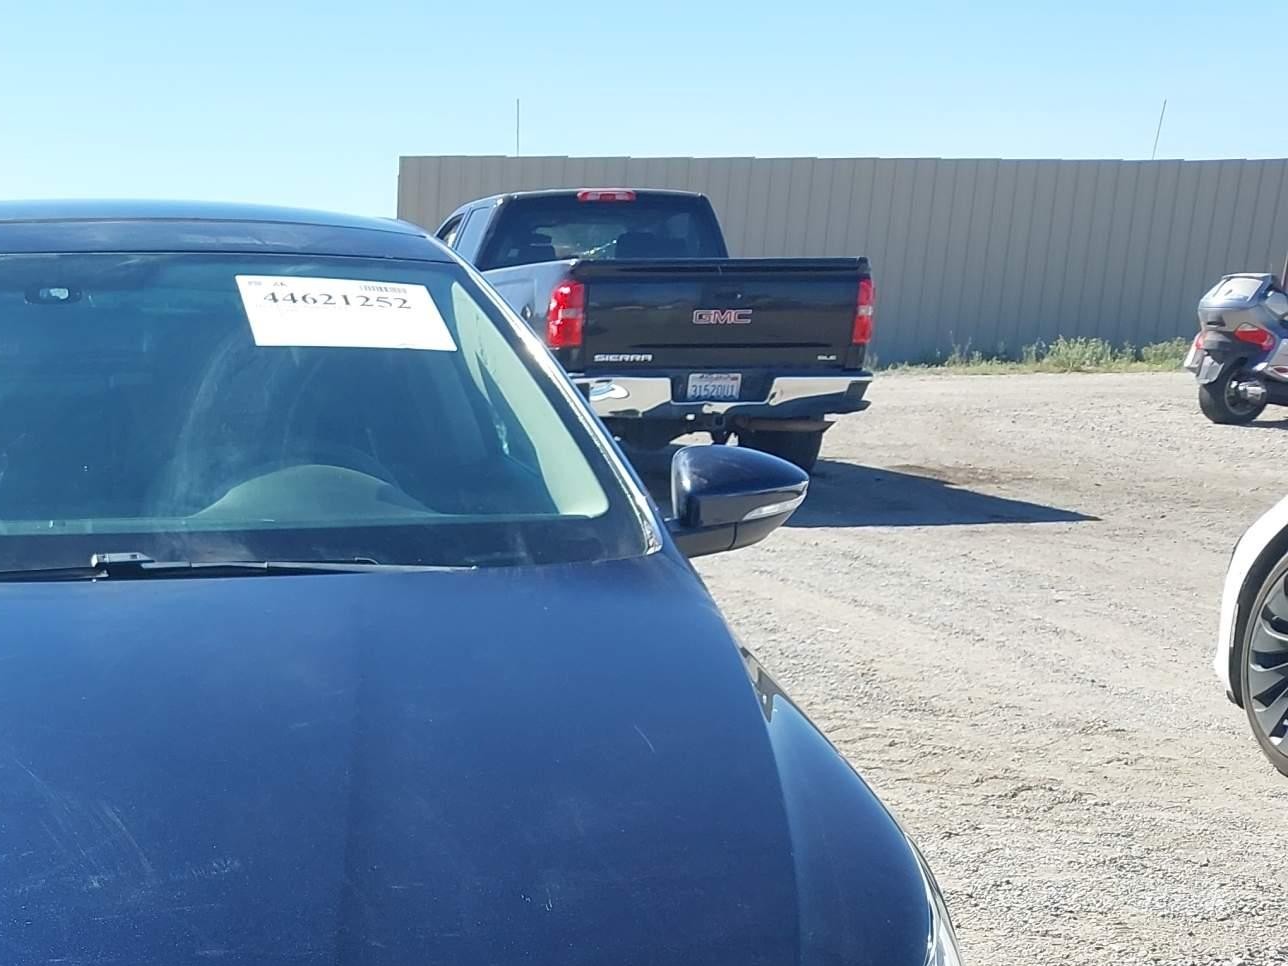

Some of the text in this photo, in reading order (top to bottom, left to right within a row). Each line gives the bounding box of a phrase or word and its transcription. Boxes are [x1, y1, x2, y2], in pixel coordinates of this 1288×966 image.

[263, 291, 412, 309] 44621252
[692, 309, 753, 325] GMC
[593, 354, 653, 362] SIERRA
